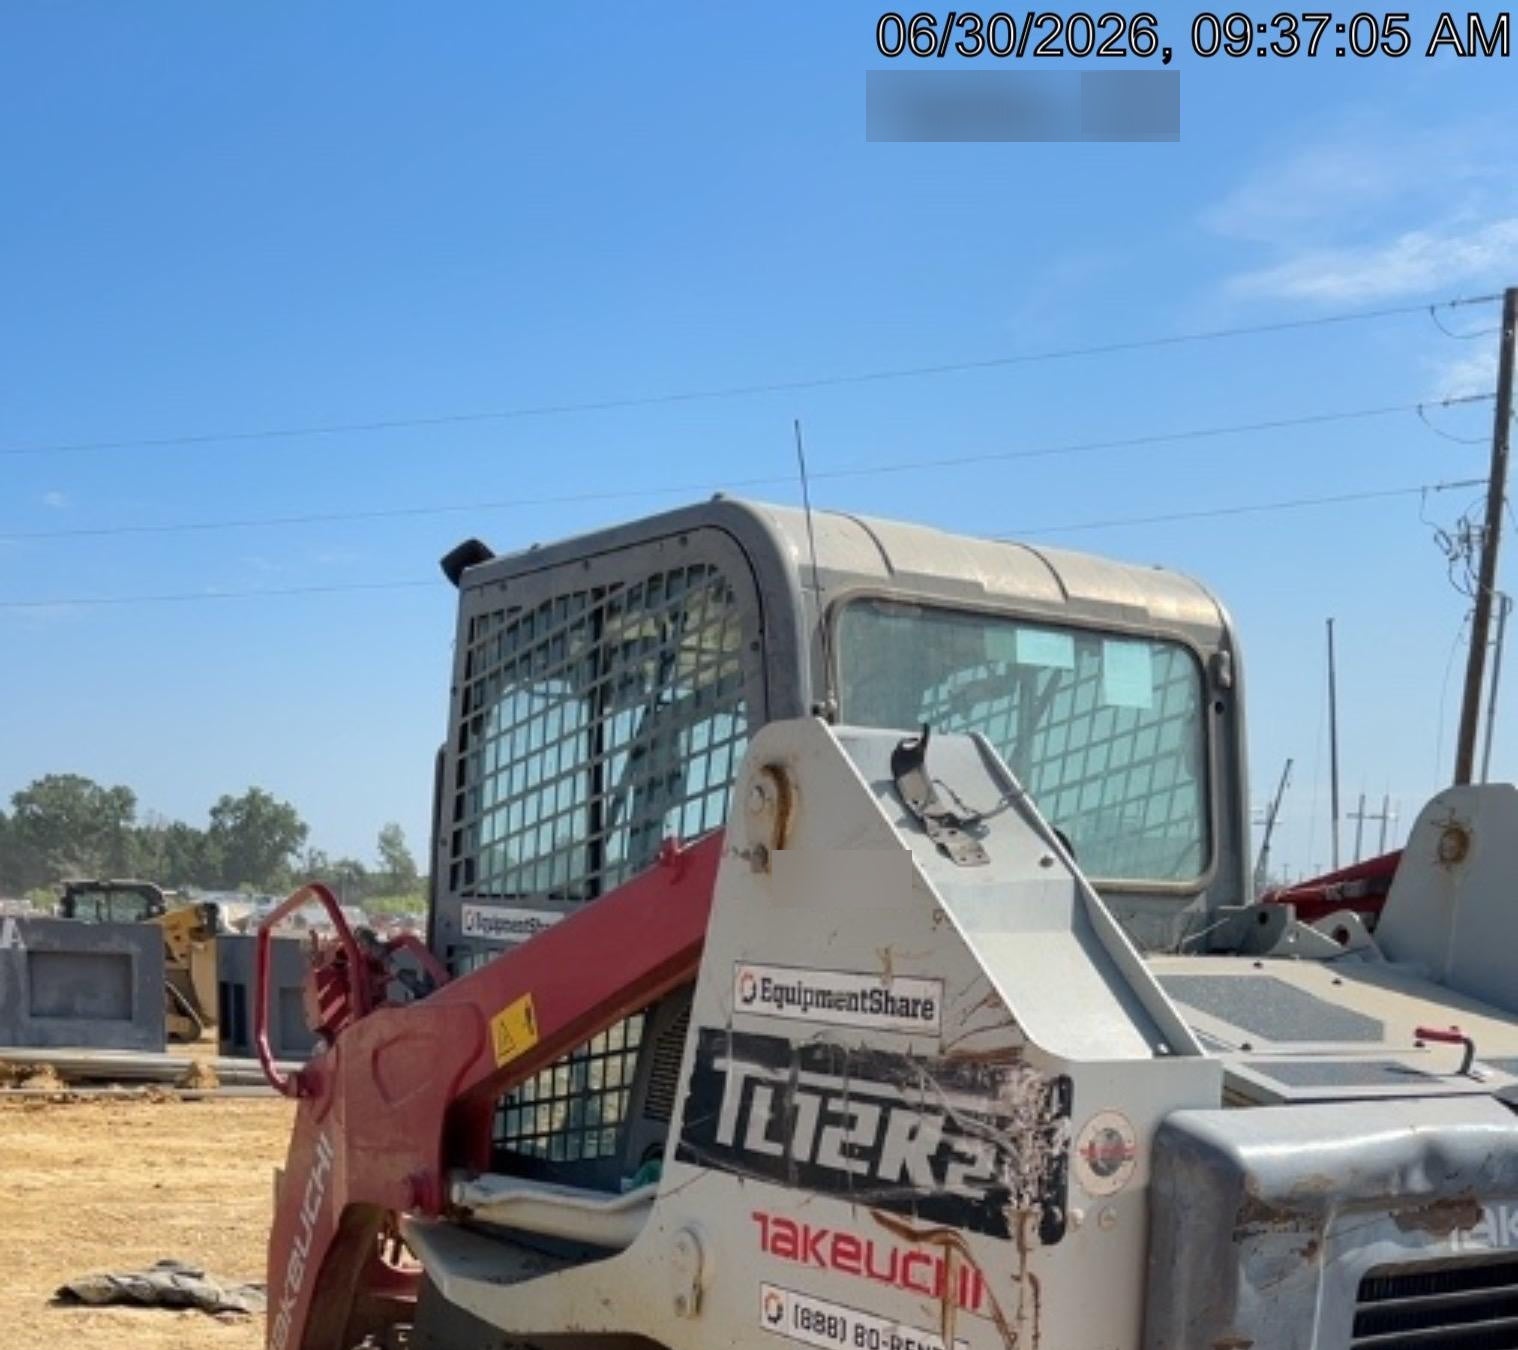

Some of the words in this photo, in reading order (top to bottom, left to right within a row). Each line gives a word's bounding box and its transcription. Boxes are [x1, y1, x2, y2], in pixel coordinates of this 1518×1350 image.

[760, 977, 935, 1021] EquipmentShare
[713, 1057, 999, 1201] TL12R2
[794, 1304, 847, 1343] (888)
